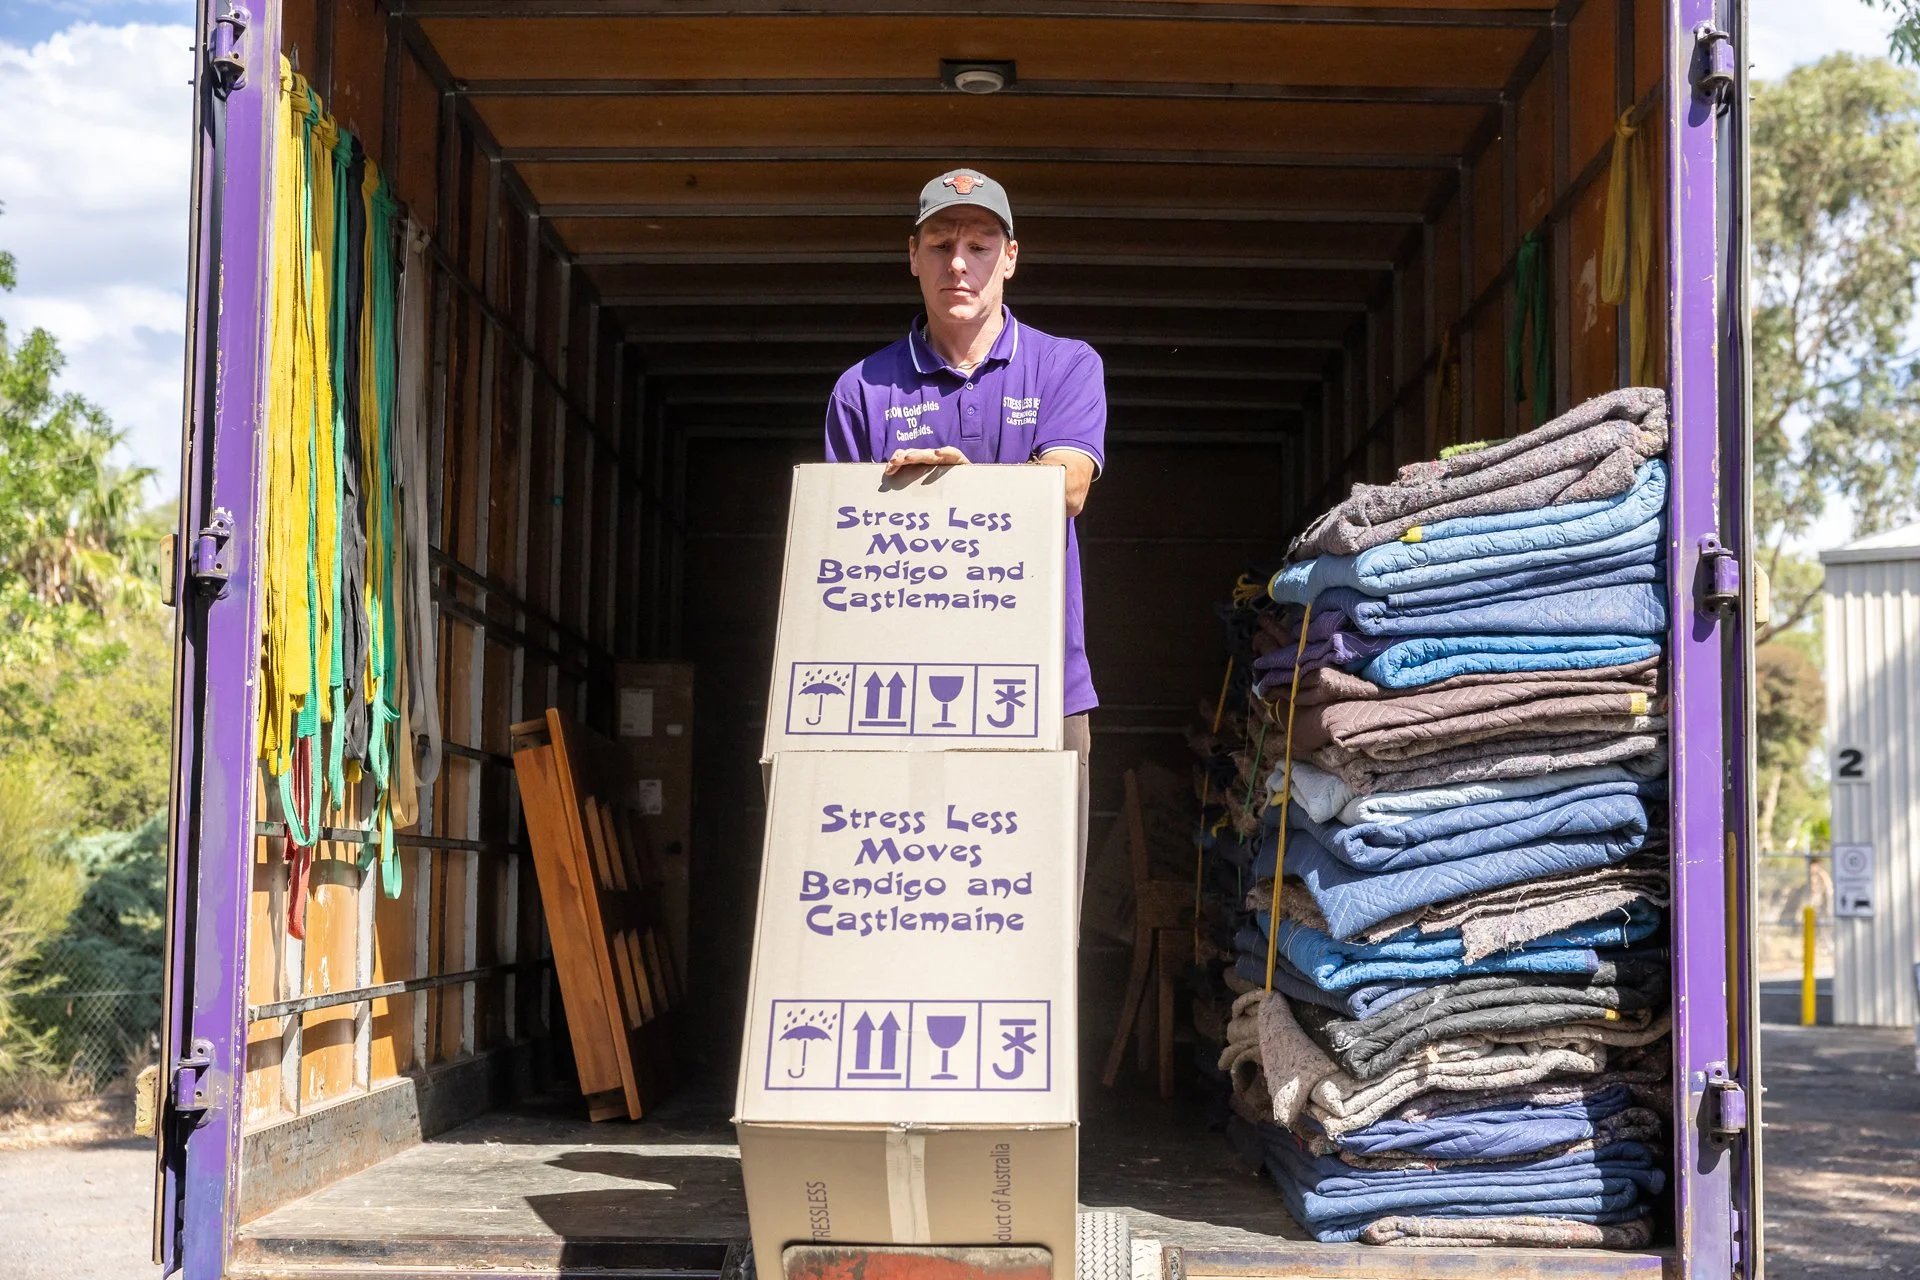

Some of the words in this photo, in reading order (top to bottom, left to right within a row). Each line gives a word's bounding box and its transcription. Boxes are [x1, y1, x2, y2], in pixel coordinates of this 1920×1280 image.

[907, 417, 917, 428] TO
[837, 506, 930, 531] Stress
[949, 507, 1012, 532] Less
[866, 533, 980, 558] Moves
[817, 559, 948, 585] Bendigo
[966, 561, 1025, 583] and
[822, 586, 1017, 613] Castlemaine
[1838, 748, 1864, 777] 2
[821, 804, 926, 835] Stress
[947, 804, 1018, 835] Less
[854, 837, 983, 868] Moves
[799, 870, 947, 902] Bendigo
[967, 871, 1033, 899] and
[806, 904, 1024, 937] Castlemaine
[990, 1143, 1011, 1197] Australia
[991, 1199, 1011, 1212] of
